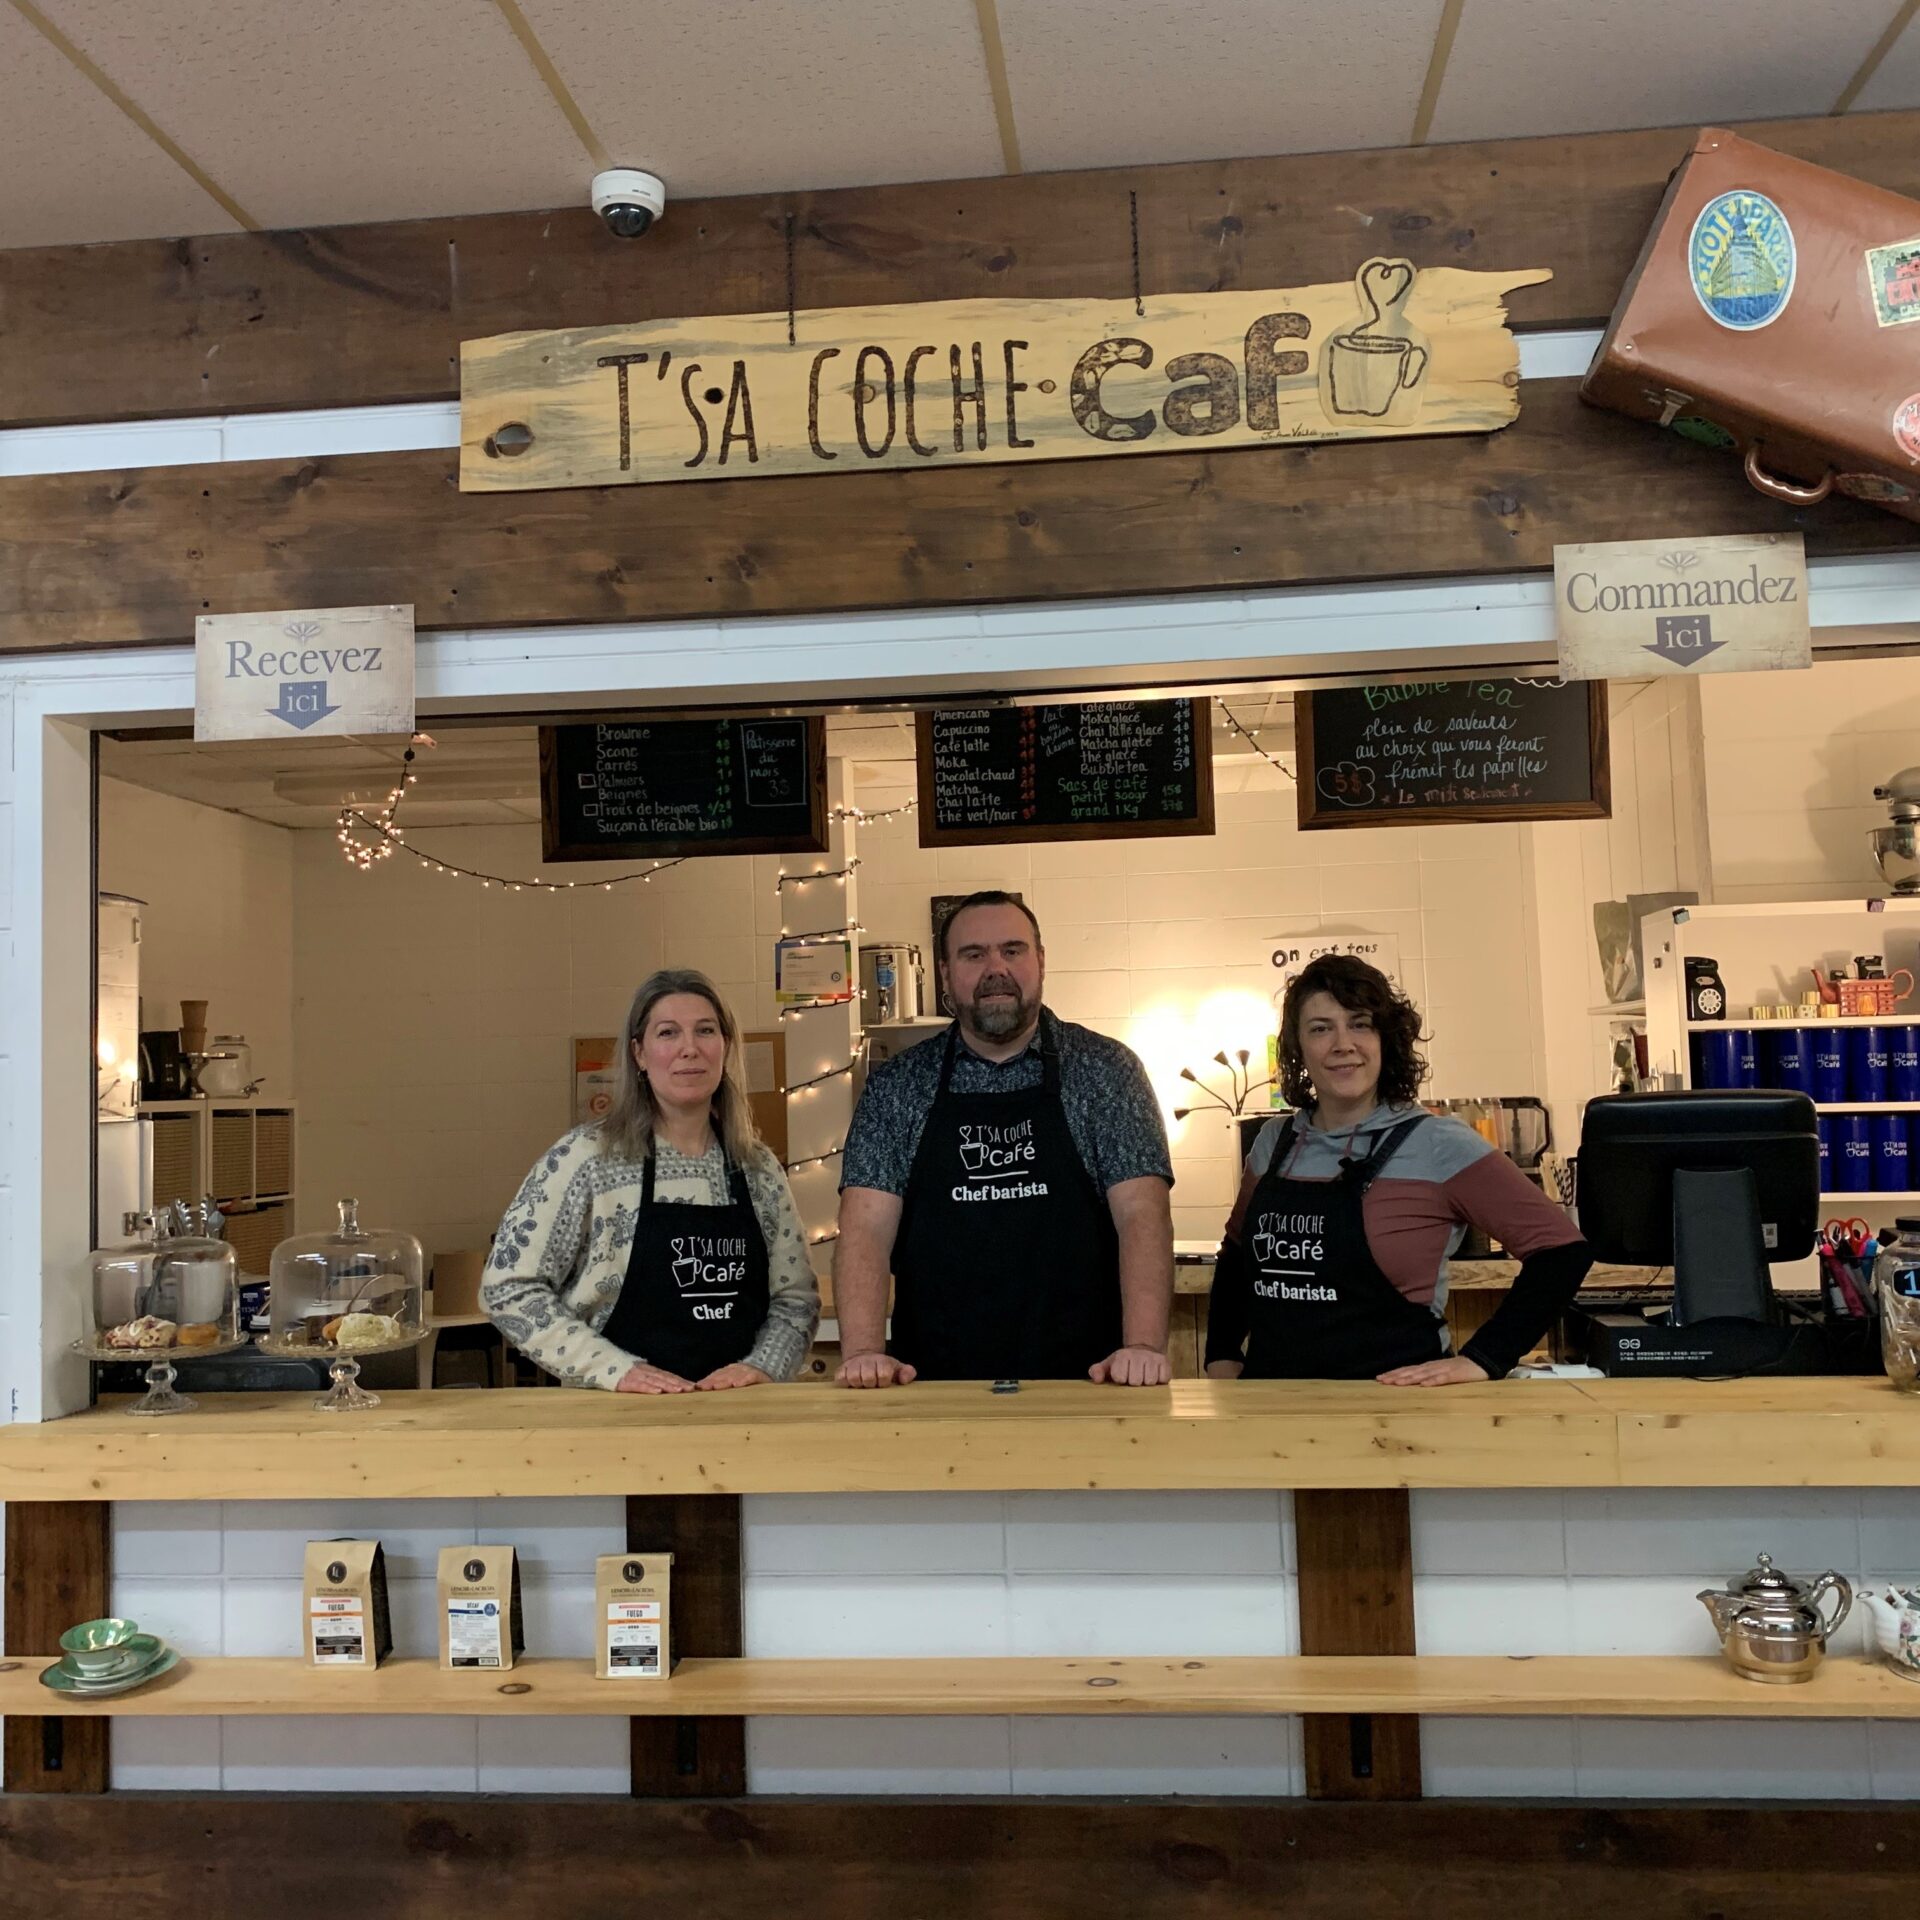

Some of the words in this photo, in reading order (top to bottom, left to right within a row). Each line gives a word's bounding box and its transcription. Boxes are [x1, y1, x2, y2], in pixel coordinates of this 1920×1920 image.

[597, 351, 759, 471] T'SA
[808, 339, 1035, 460] COCHE
[1566, 564, 1798, 613] Commandez
[1665, 618, 1704, 648] ici
[225, 640, 382, 678] Recevez
[286, 685, 320, 712] ici
[933, 710, 990, 721] Americano
[1361, 718, 1407, 741] plein
[1414, 716, 1440, 734] de
[1444, 709, 1519, 733] saveurs
[597, 723, 650, 742] Brownie
[933, 724, 990, 742] Capuccino
[1080, 725, 1105, 738] Chai
[597, 744, 639, 760] Scone
[1080, 737, 1120, 752] Matcha
[1356, 743, 1380, 760] au
[1383, 737, 1427, 764] choix
[1432, 739, 1456, 766] qui
[1460, 738, 1493, 752] vous
[1496, 735, 1548, 763] feront
[758, 752, 778, 765] du
[935, 767, 980, 784] Chocolat
[980, 768, 1016, 781] chaud
[1080, 762, 1124, 777] Bubble
[1127, 760, 1150, 773] tea
[1452, 758, 1476, 779] les
[1482, 756, 1548, 783] papilles
[598, 772, 646, 789] Palmiers
[1057, 777, 1088, 793] Sacs
[1093, 776, 1110, 791] de
[1113, 773, 1149, 791] café
[599, 787, 649, 806] Beignes
[936, 783, 983, 798] Matcha
[1071, 789, 1109, 806] petit
[1399, 788, 1416, 804] Le
[936, 797, 964, 809] Chai
[967, 792, 1002, 808] latte
[600, 800, 635, 817] Trous
[637, 802, 653, 816] de
[655, 800, 701, 821] beignes
[936, 809, 963, 824] thé
[1070, 802, 1111, 820] grand
[597, 817, 638, 837] Suçon
[698, 817, 719, 832] bio
[1272, 949, 1300, 968] On
[1309, 944, 1340, 960] est
[1346, 943, 1379, 956] tous
[976, 1125, 1001, 1143] T'SA
[1003, 1120, 1034, 1144] COCHE
[989, 1141, 1036, 1167] Café
[952, 1185, 990, 1201] Chef
[991, 1182, 1048, 1200] barista
[1290, 1214, 1325, 1234] COCHE
[688, 1236, 714, 1257] T'SA
[717, 1238, 747, 1257] COCHE
[1275, 1239, 1324, 1261] Café
[702, 1261, 746, 1282] Café
[1254, 1280, 1279, 1298] Chef
[1280, 1283, 1338, 1301] barista
[692, 1302, 734, 1320] Chef
